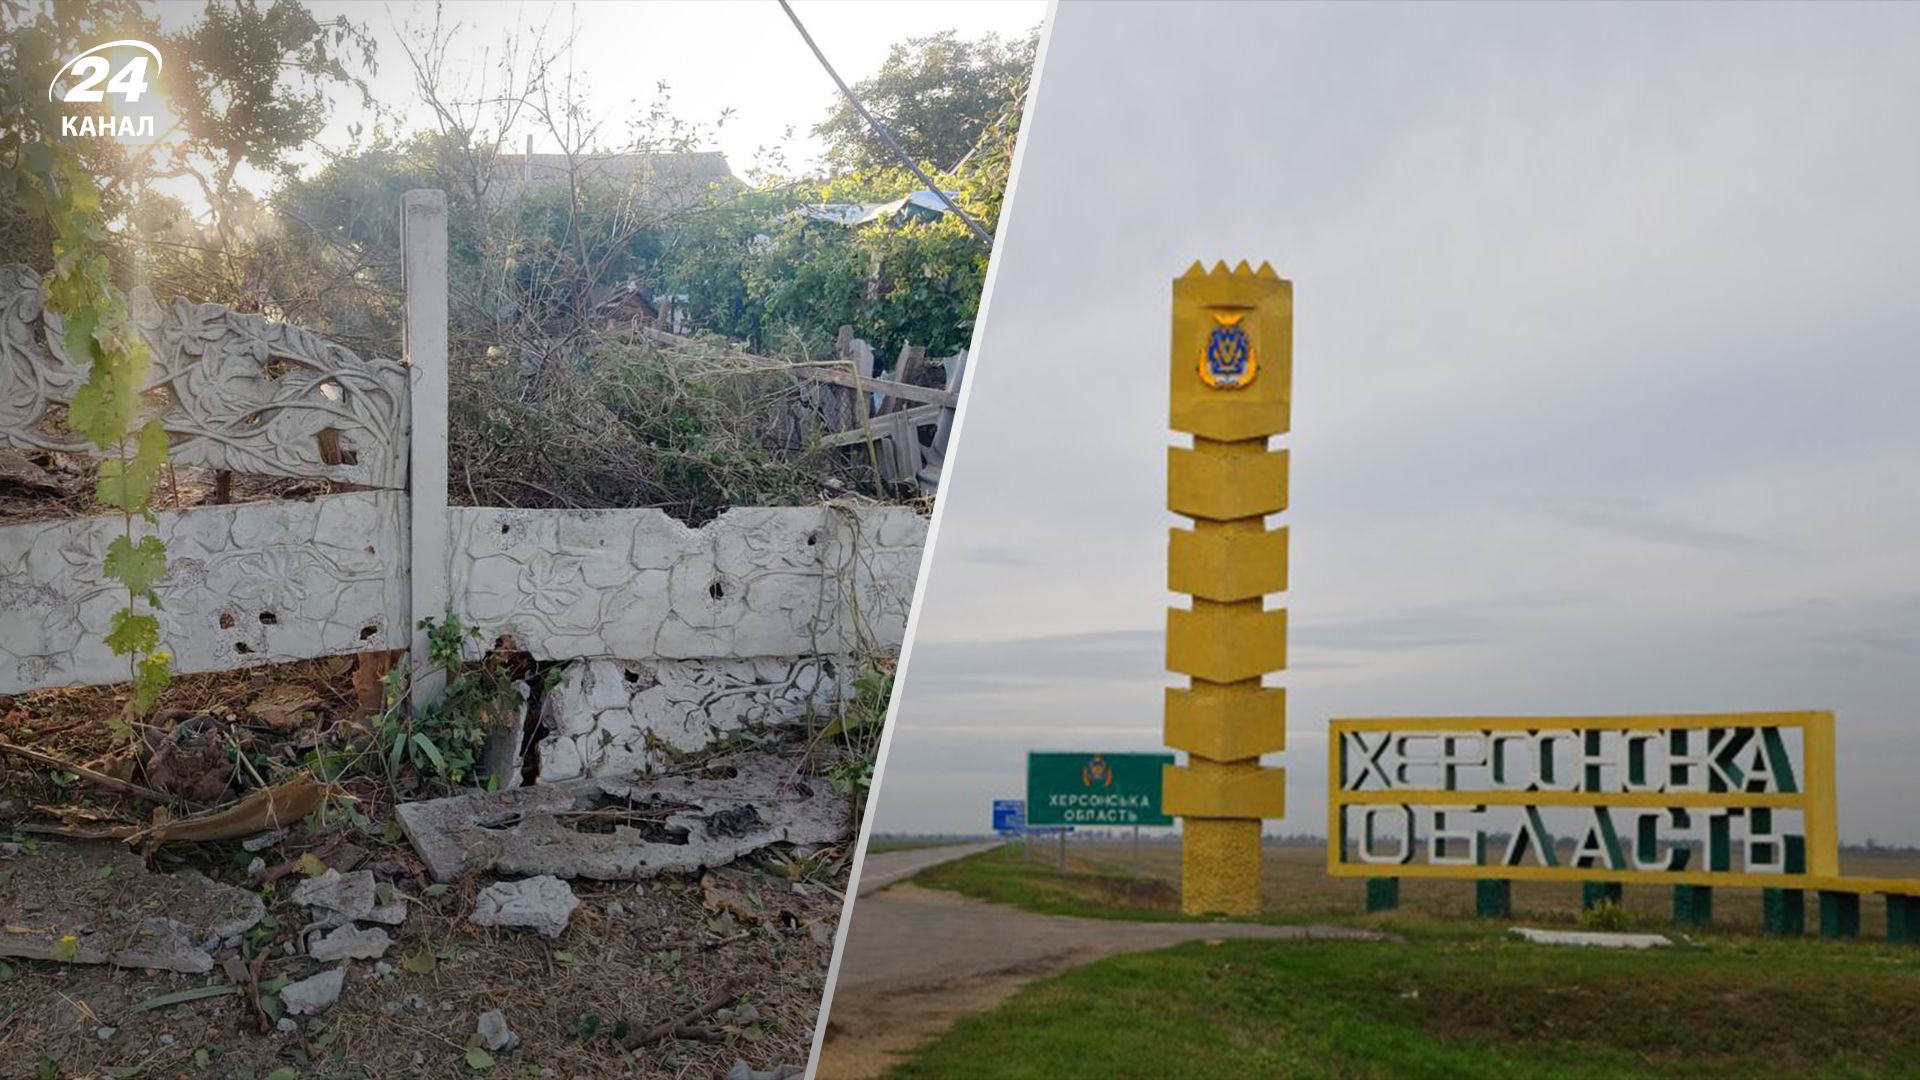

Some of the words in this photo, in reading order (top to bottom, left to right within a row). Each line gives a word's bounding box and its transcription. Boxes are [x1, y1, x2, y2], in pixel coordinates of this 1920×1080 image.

[1341, 726, 1798, 793] ХЕРСОНСЬКА
[1048, 794, 1150, 808] ХЕРСОНСЬКА
[1063, 809, 1138, 822] ОБЛАСТЬ
[1357, 803, 1804, 874] ОБЛАСТЬ
